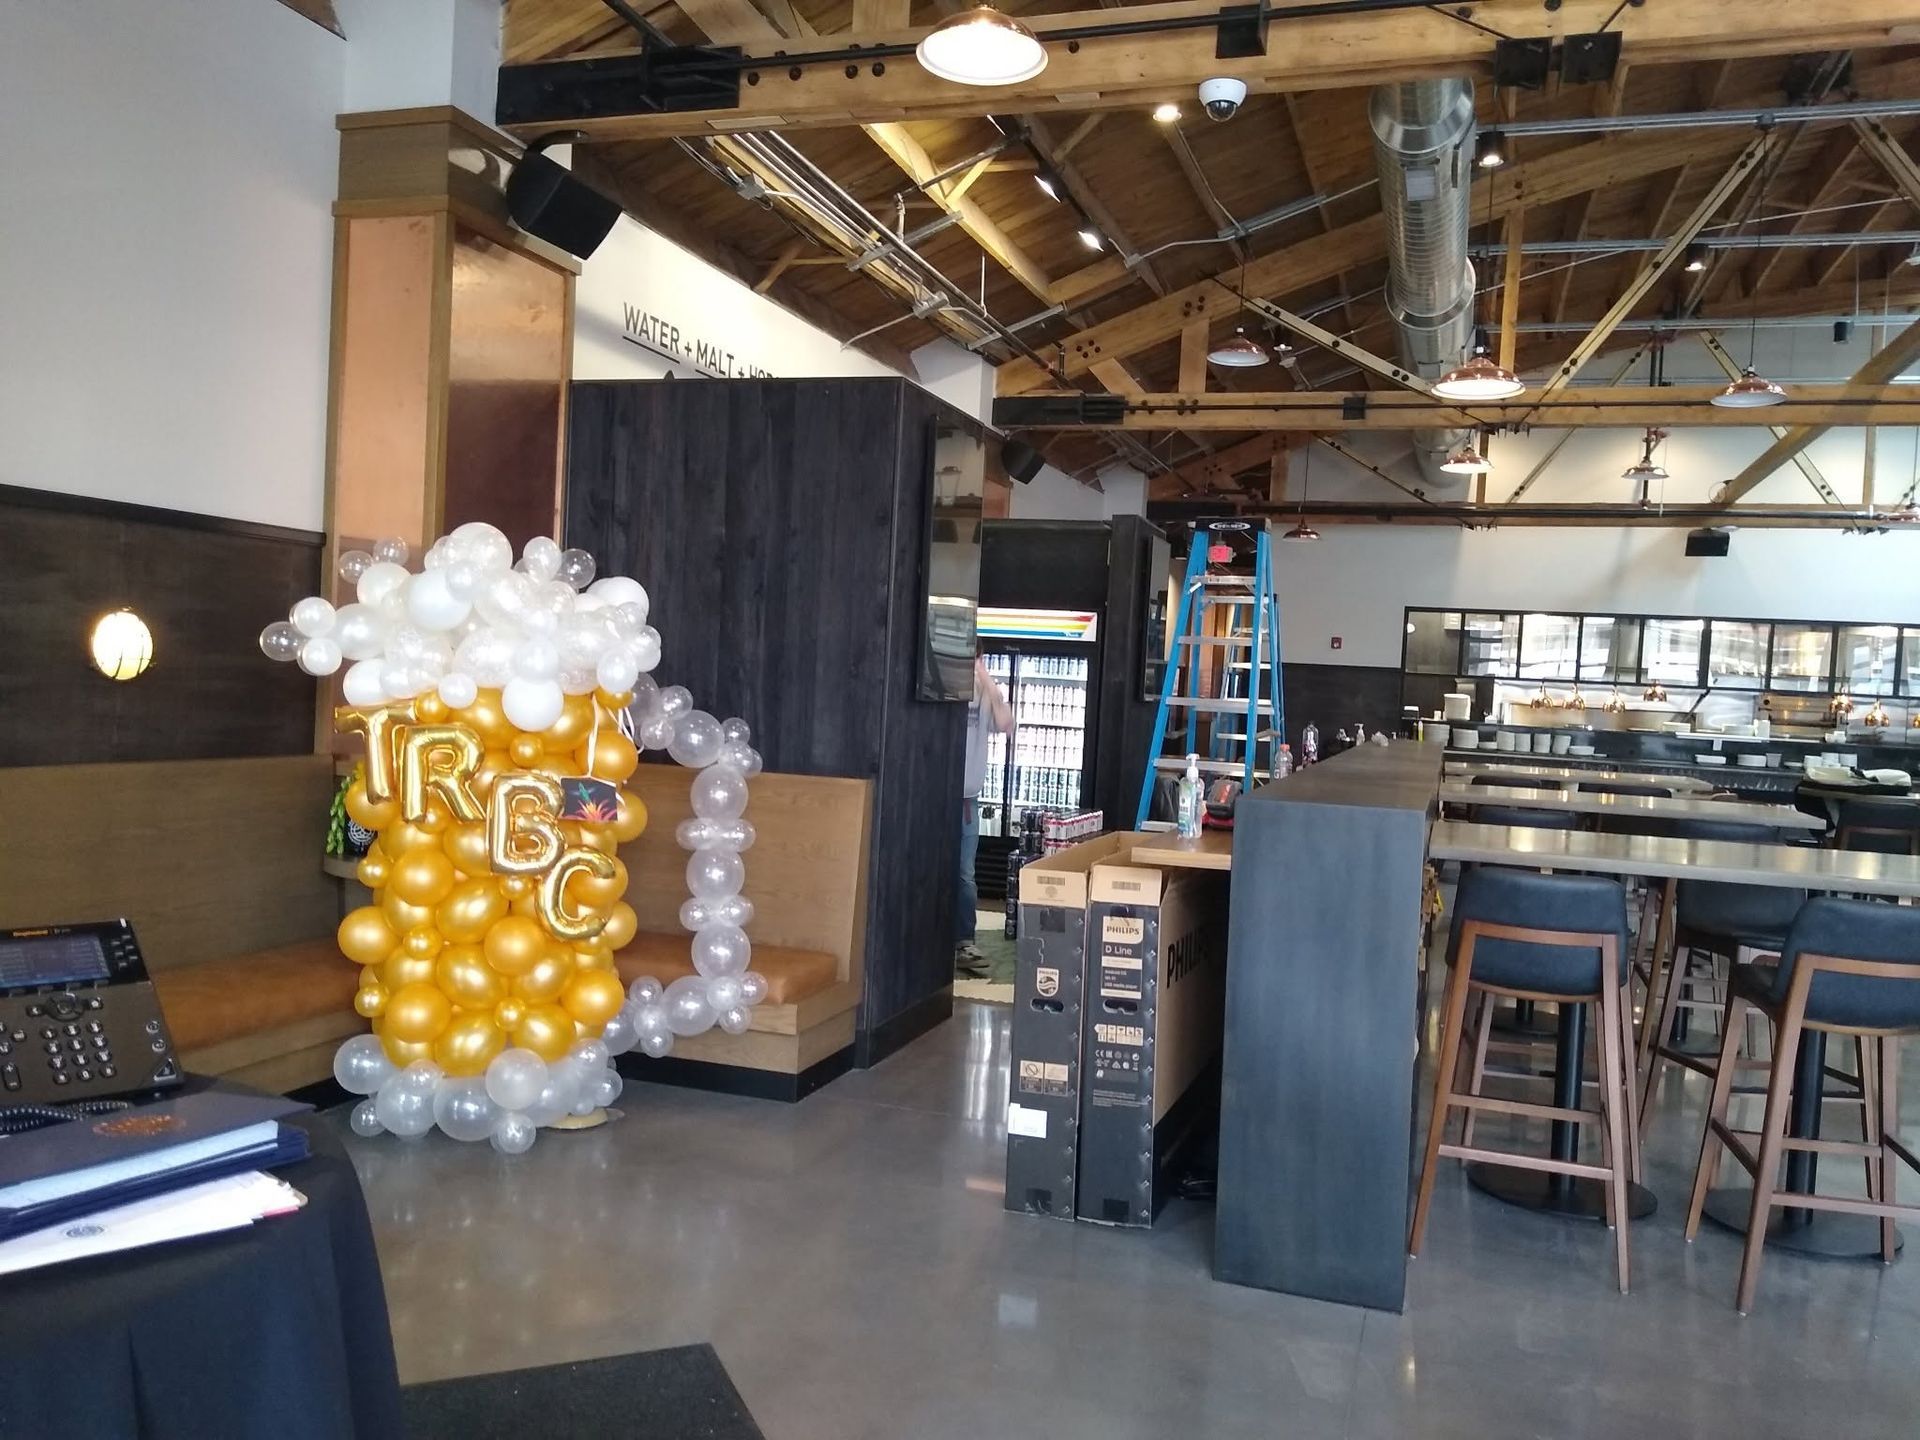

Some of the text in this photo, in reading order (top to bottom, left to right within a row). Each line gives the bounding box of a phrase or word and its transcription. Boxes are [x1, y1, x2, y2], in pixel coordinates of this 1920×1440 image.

[623, 301, 680, 355] WATER
[696, 338, 735, 379] MALT
[1106, 925, 1140, 935] PHILIPS
[1105, 945, 1132, 955] D Line
